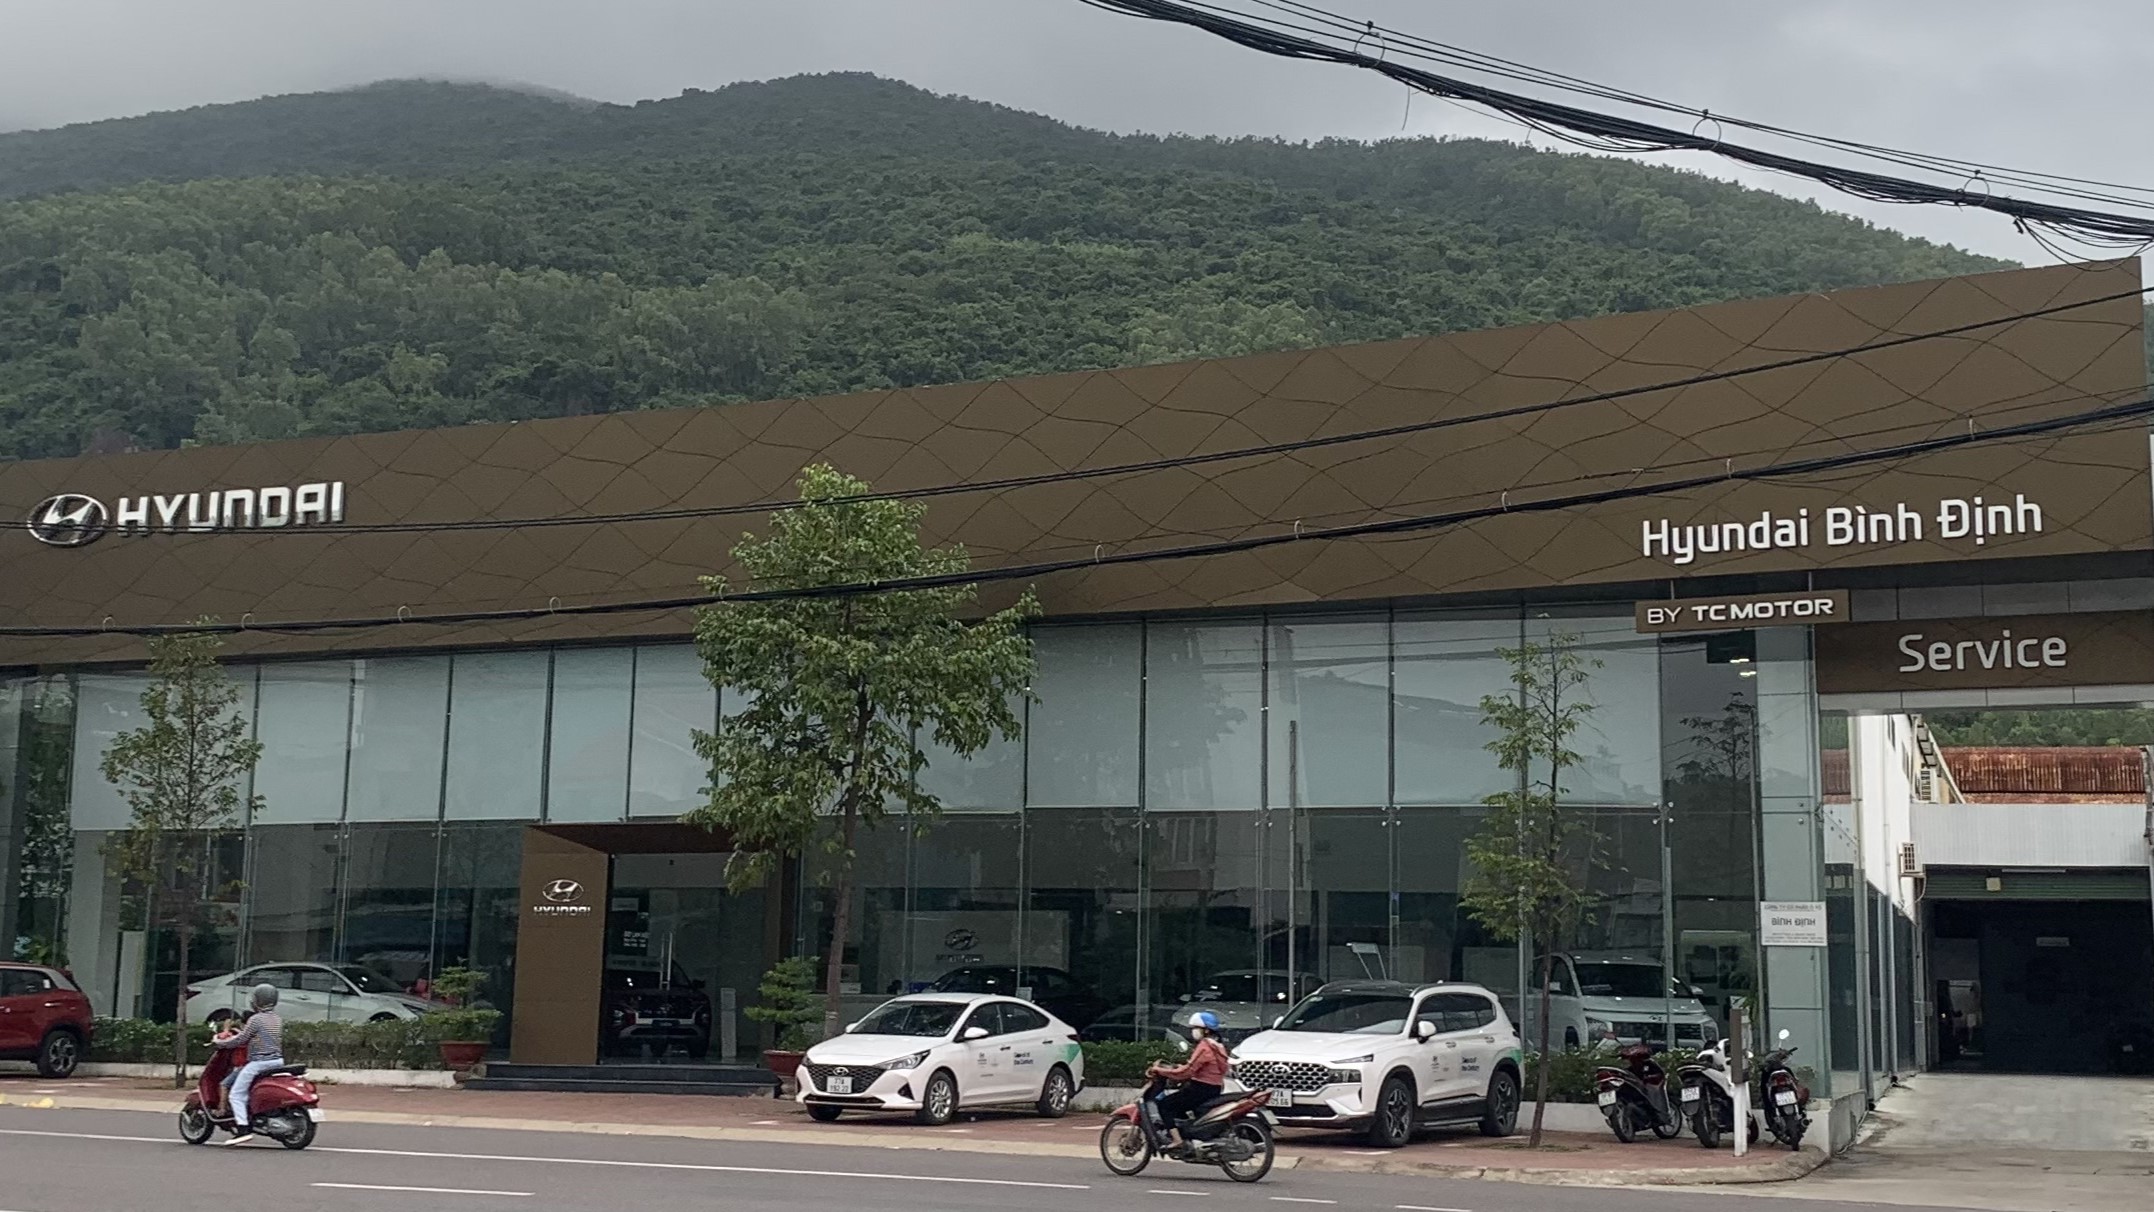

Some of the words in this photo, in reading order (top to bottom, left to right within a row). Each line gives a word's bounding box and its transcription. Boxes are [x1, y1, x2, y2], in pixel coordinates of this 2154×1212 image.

[117, 481, 345, 537] HYUNDAI
[1642, 507, 1809, 565] Hyundai
[1825, 502, 1923, 546] Bình
[1936, 493, 2043, 545] Định
[1646, 606, 1682, 625] BY
[1898, 629, 2068, 673] Service
[533, 905, 592, 917] HYUNDAI
